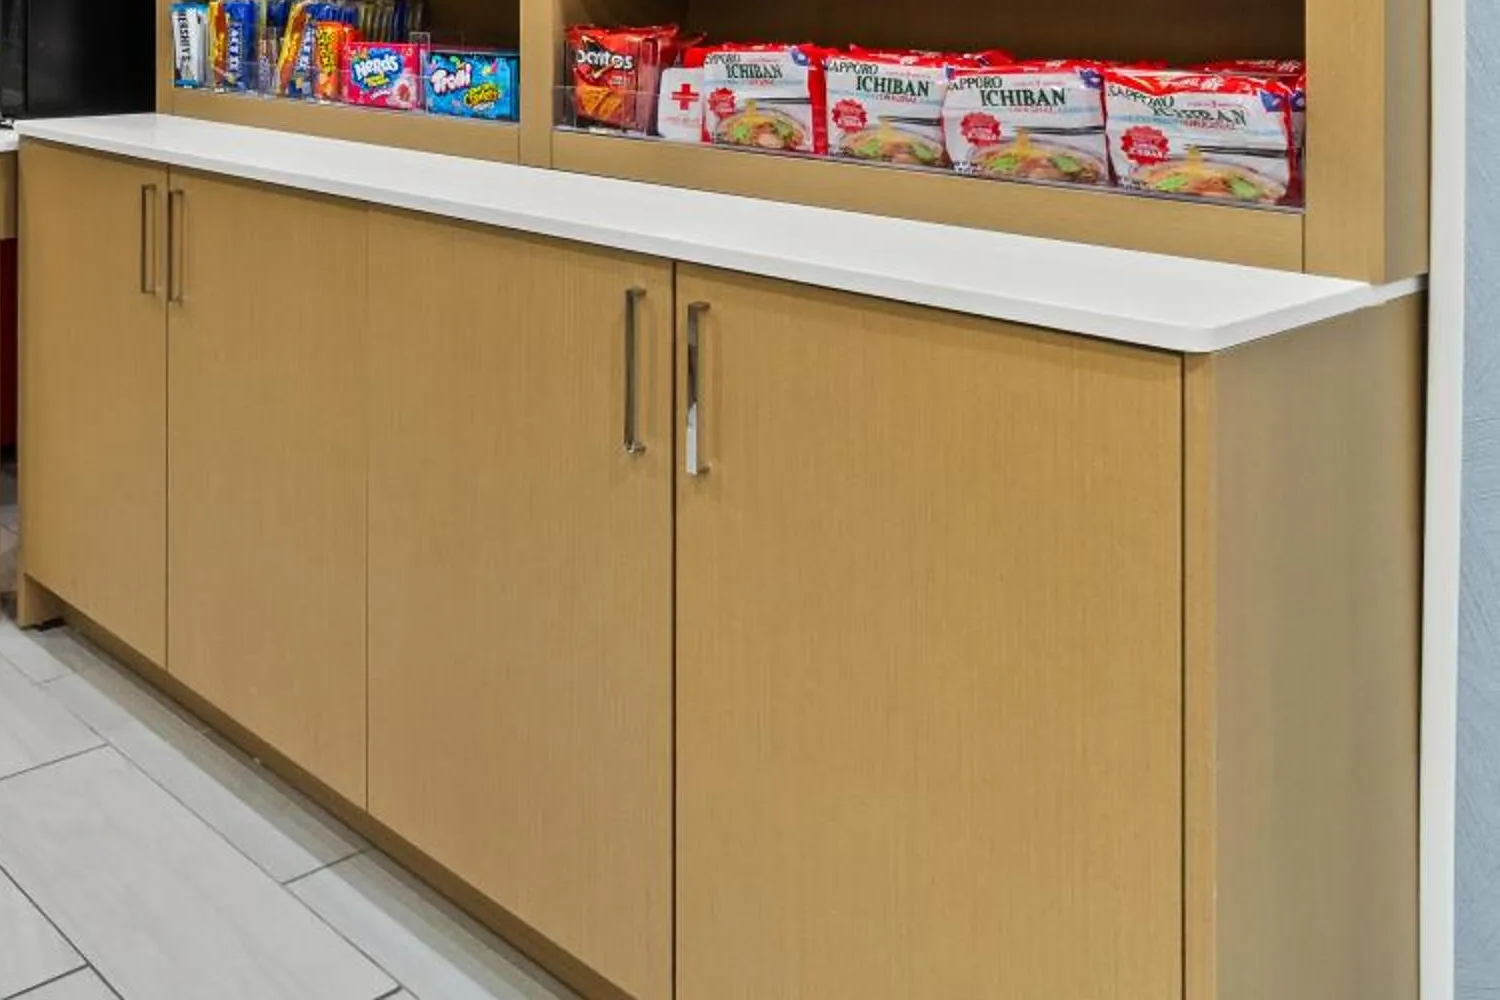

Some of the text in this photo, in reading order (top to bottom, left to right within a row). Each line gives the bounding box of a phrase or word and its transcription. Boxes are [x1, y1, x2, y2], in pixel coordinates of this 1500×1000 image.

[576, 50, 633, 69] Doritos
[431, 63, 472, 95] Trolli
[725, 63, 783, 79] ICHIBAN
[856, 75, 929, 97] ICHIBAN
[981, 88, 1066, 107] ICHIBAN
